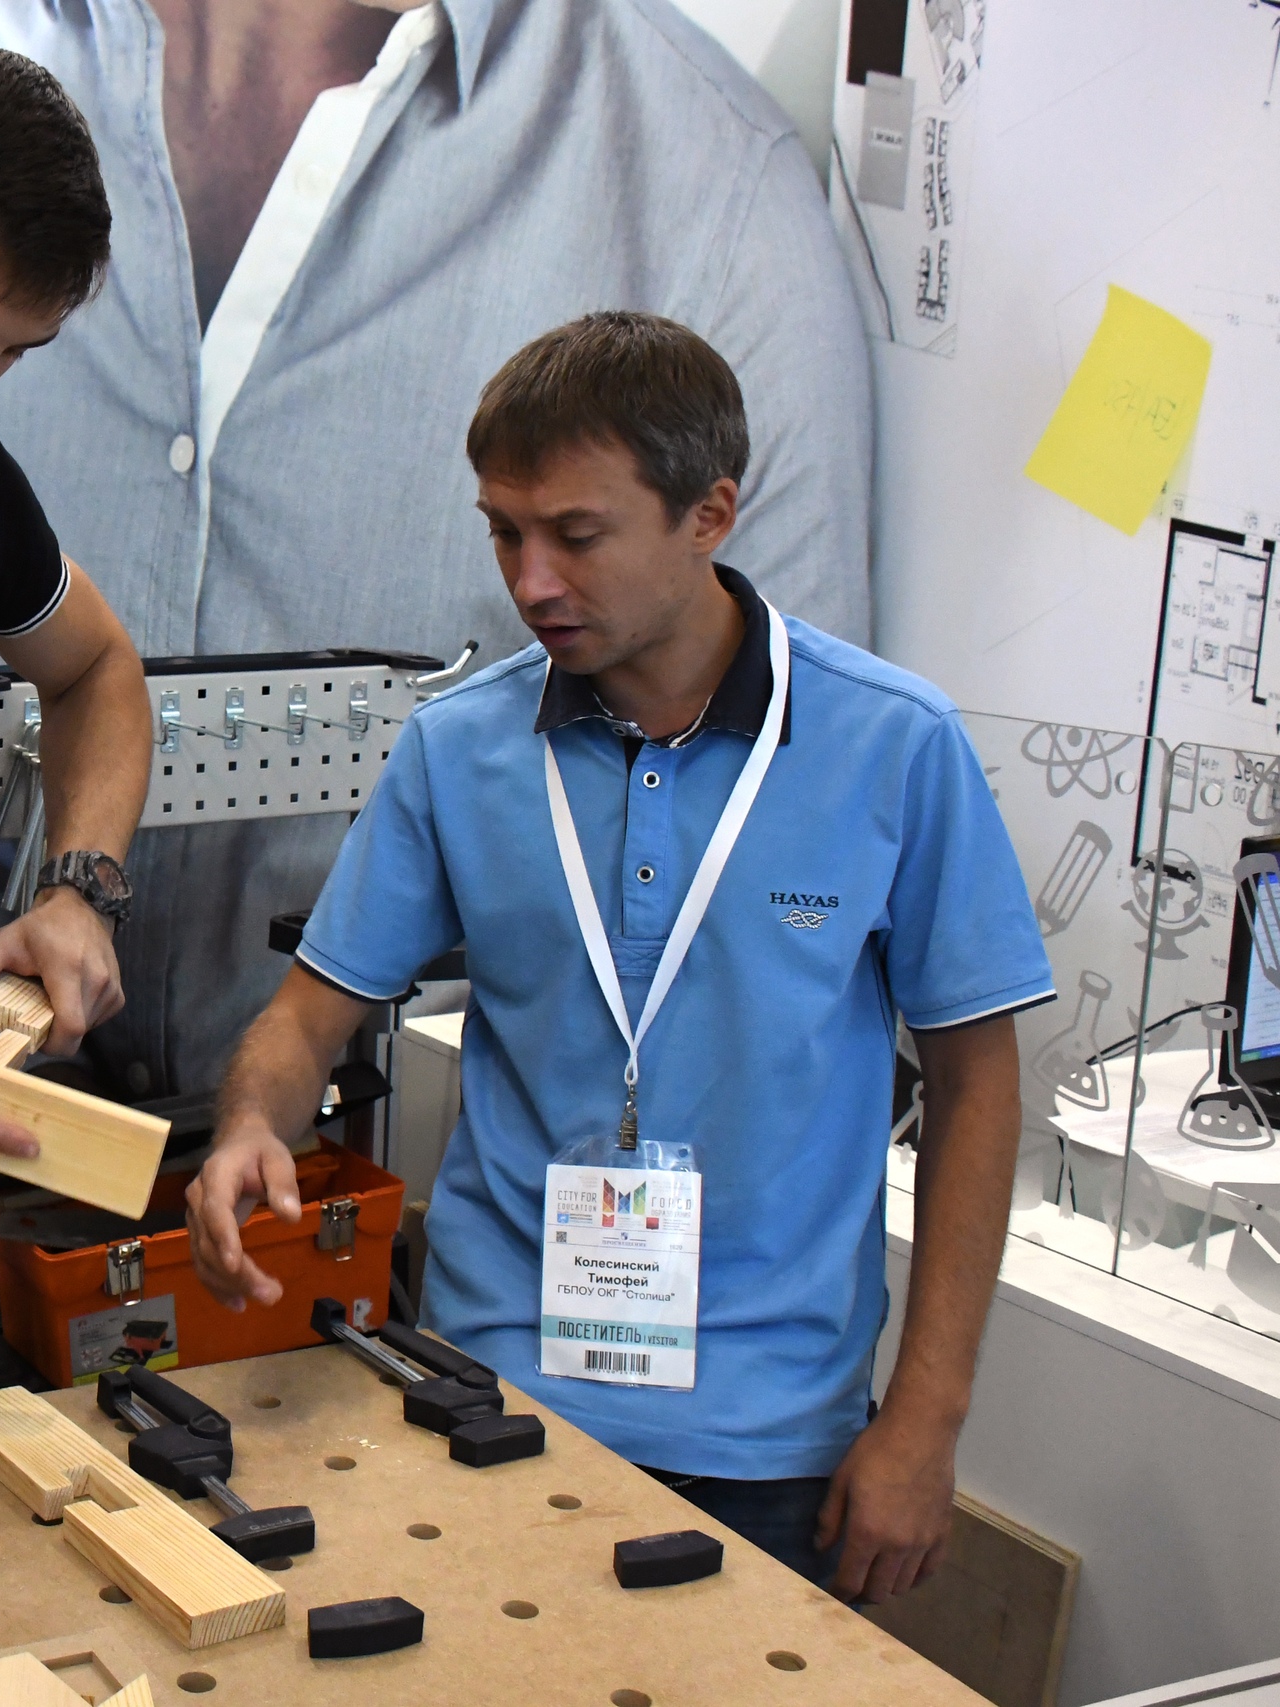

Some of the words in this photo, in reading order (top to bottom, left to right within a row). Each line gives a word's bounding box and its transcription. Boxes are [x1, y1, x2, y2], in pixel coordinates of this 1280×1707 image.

[769, 892, 839, 908] HAYAS
[557, 1189, 579, 1201] CITY
[580, 1191, 598, 1203] FOR
[651, 1196, 692, 1211] ГОРОД
[557, 1202, 597, 1212] EDUCATION
[574, 1255, 660, 1273] Колесинский
[587, 1272, 649, 1288] Тимофей
[557, 1284, 595, 1297] ГБПОУ
[598, 1286, 620, 1298] ОКГ
[622, 1289, 676, 1302] "Столица"
[558, 1320, 642, 1344] ПОСЕТИТЕЛЬ
[646, 1334, 678, 1347] VISITOR
